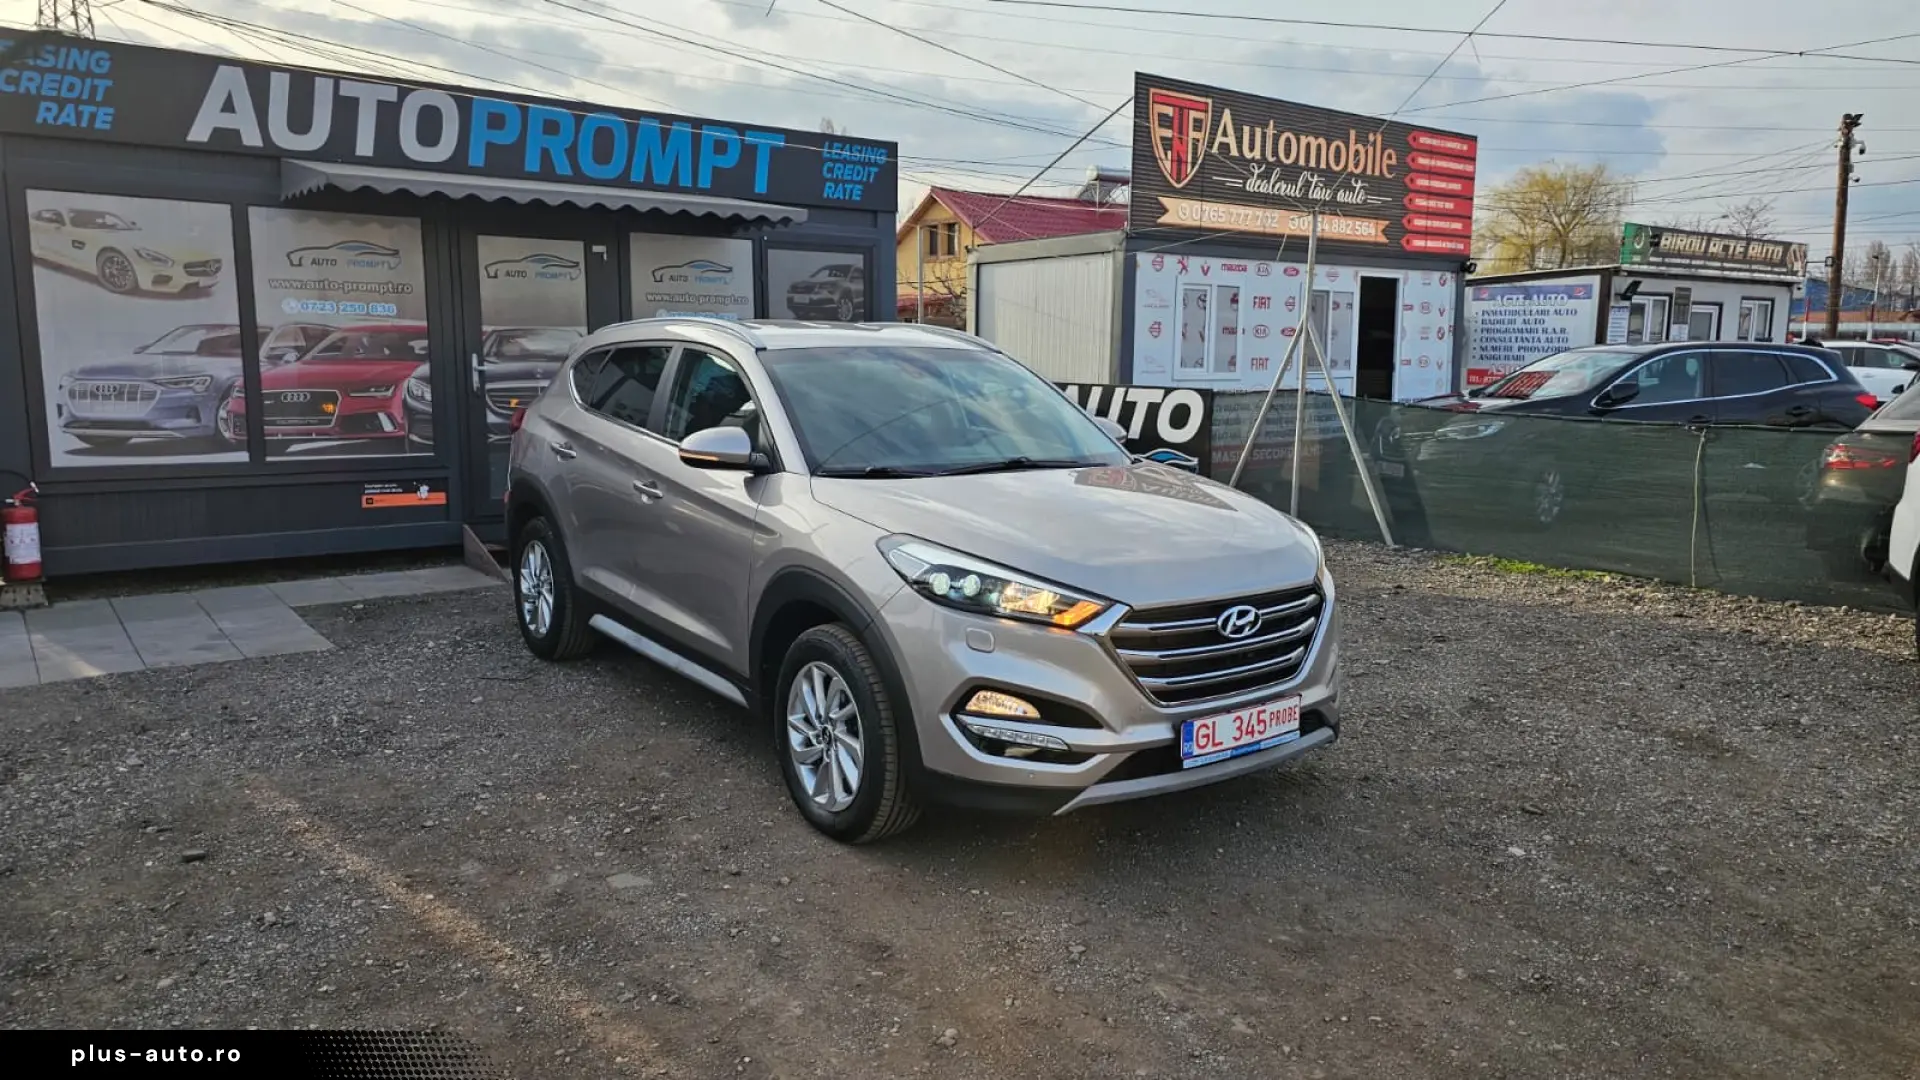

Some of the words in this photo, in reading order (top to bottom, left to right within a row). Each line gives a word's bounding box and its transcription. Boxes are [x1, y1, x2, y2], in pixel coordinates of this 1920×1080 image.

[0, 67, 113, 102] CREDIT
[35, 101, 115, 130] RATE
[1212, 107, 1397, 178] Automobile
[822, 141, 888, 165] LEASING
[822, 161, 879, 183] CREDIT
[823, 181, 864, 201] RATE
[1245, 163, 1308, 198] dealerul
[1336, 177, 1369, 205] auto
[310, 255, 337, 267] AUTO
[504, 269, 528, 279] AUTO
[668, 274, 689, 283] AUTO
[268, 277, 413, 295] www.auto-prompt.ro
[1253, 296, 1272, 311] FIAT
[1528, 293, 1569, 307] AUTO
[1553, 308, 1578, 317] AUTO
[1520, 318, 1546, 326] AUTO
[1250, 357, 1270, 372] FIAT
[1195, 720, 1224, 750] GL
[1232, 708, 1267, 742] 345
[1269, 704, 1298, 728] PROBE
